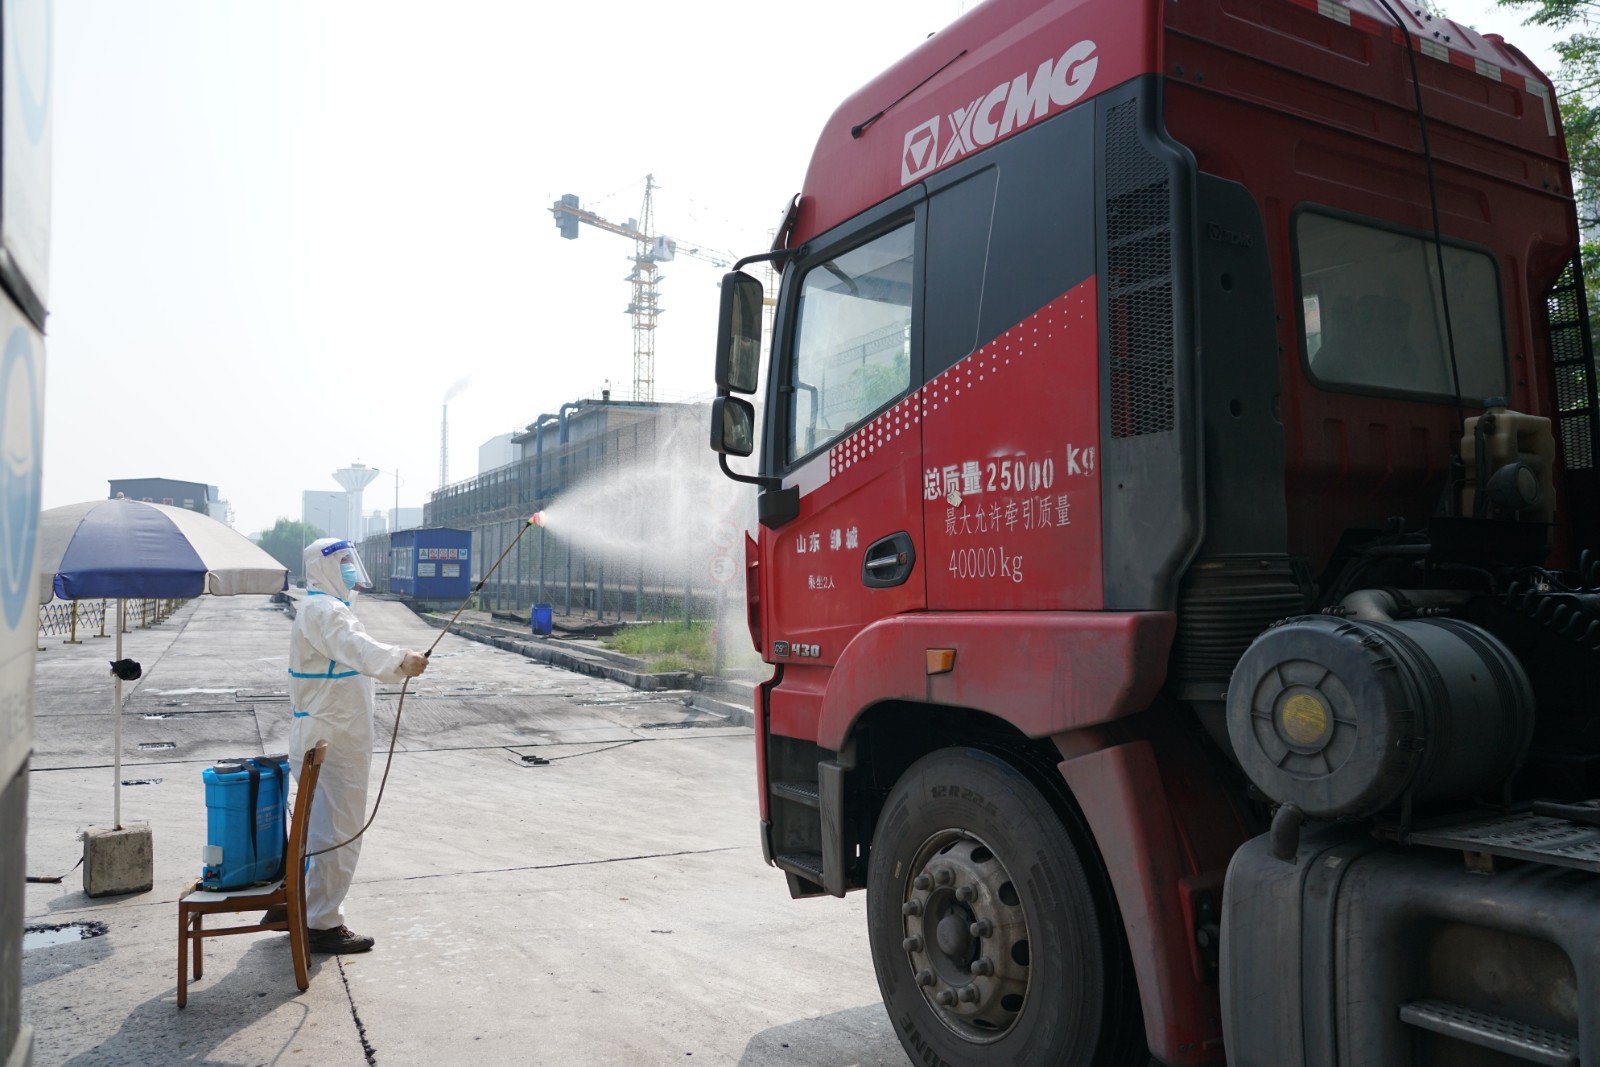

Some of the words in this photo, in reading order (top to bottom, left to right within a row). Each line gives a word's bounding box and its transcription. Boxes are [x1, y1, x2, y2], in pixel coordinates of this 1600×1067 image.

[936, 39, 1099, 169] XCMG
[945, 494, 1072, 536] 最大允许牵引质量
[808, 574, 835, 589] 乘坐2人
[791, 643, 820, 657] 430
